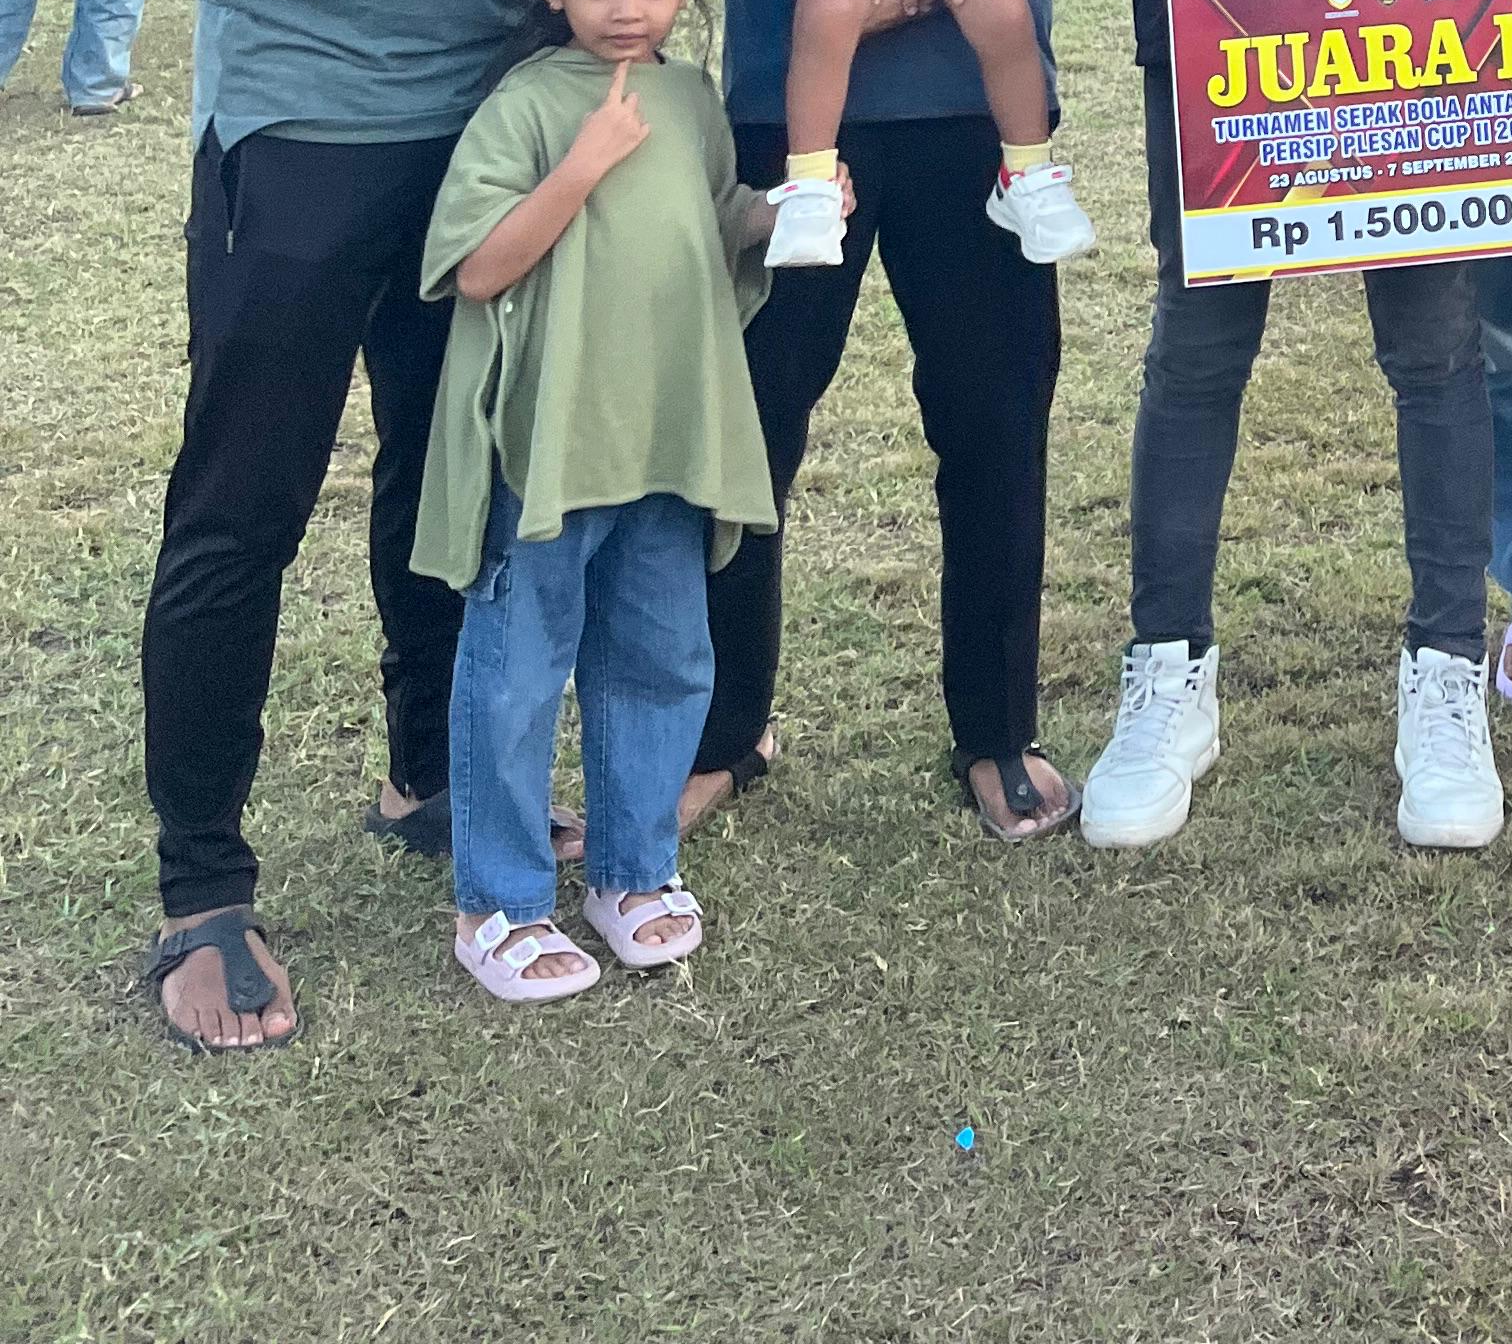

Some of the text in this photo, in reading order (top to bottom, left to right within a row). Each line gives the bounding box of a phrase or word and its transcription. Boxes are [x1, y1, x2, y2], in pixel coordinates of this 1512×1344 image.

[1207, 18, 1478, 107] JUARA
[1213, 109, 1330, 142] TURNAMEN
[1335, 101, 1402, 131] SEPAK
[1405, 96, 1462, 124] BOLA
[1261, 135, 1337, 165] PERSIP
[1341, 127, 1422, 158] PLESAN
[1425, 122, 1470, 150] CUP
[1474, 119, 1491, 145] II
[1269, 174, 1290, 188] 23
[1294, 166, 1373, 185] AGUSTUS
[1387, 164, 1397, 177] 7
[1402, 153, 1500, 175] SEPTEMBER
[1252, 217, 1309, 255] Rp
